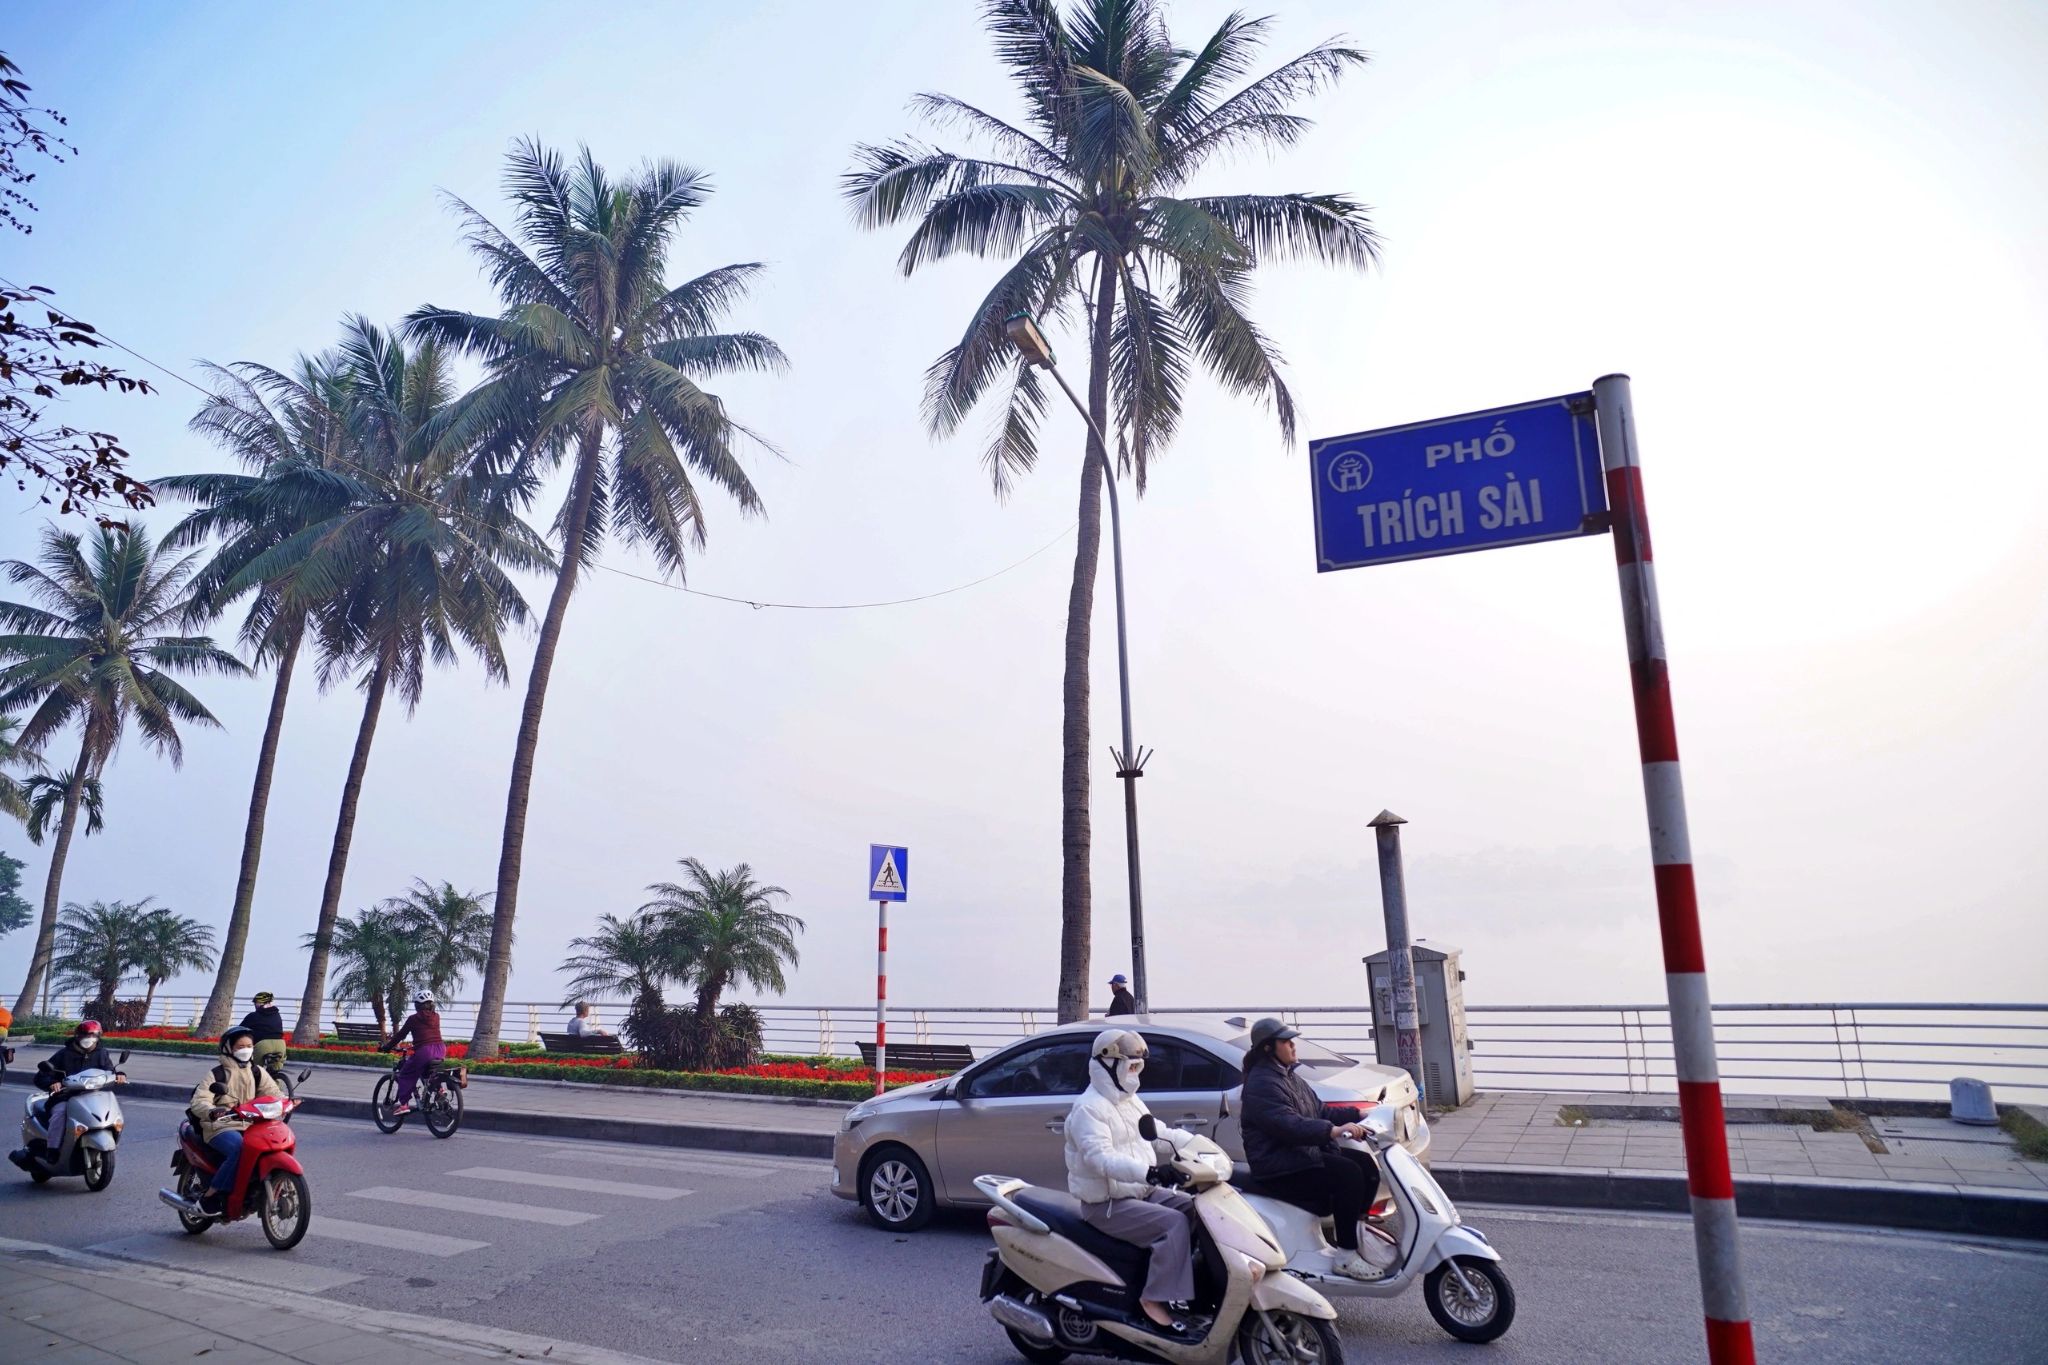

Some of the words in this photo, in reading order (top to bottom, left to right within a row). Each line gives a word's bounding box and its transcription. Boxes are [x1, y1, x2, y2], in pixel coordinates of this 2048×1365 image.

[1425, 419, 1516, 468] PHỐ
[1357, 488, 1465, 548] TRÍCH
[1478, 472, 1544, 530] SÀI
